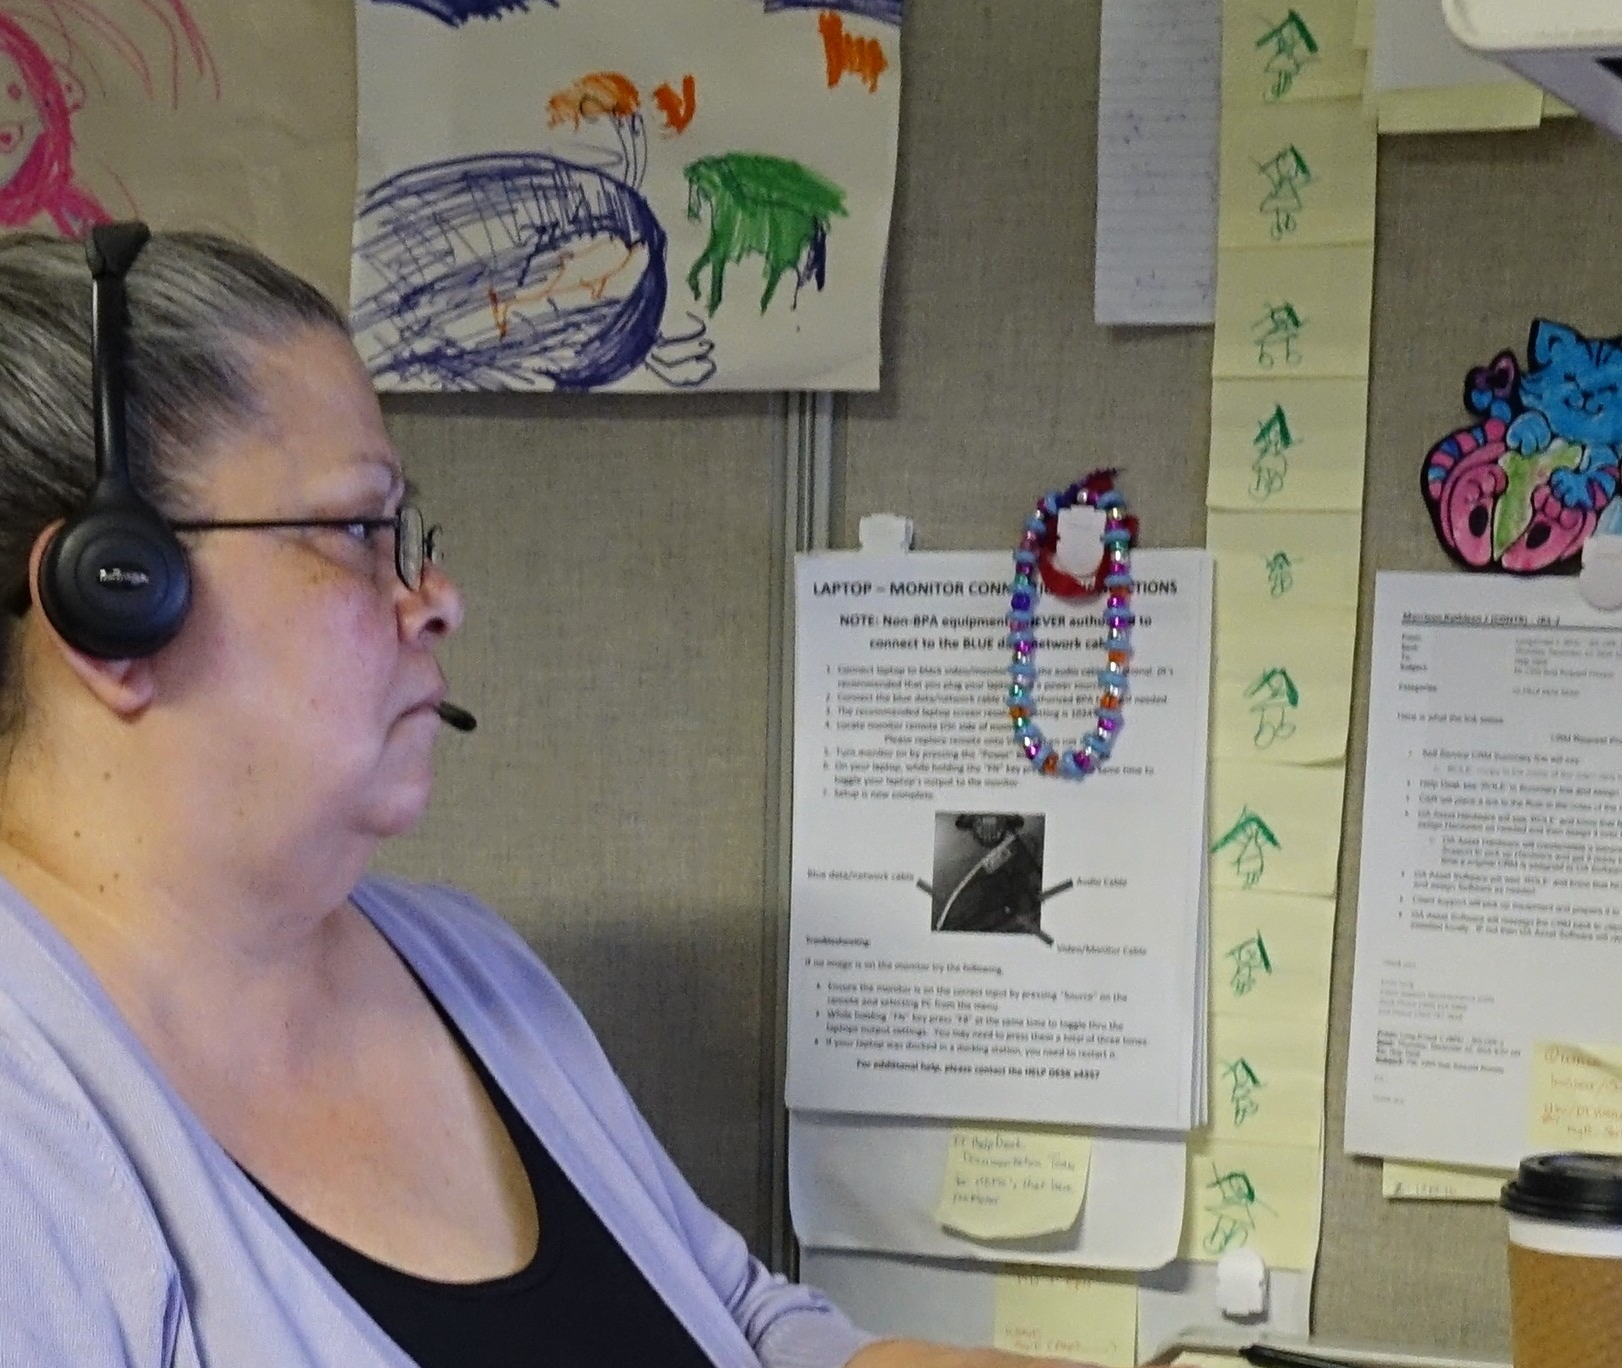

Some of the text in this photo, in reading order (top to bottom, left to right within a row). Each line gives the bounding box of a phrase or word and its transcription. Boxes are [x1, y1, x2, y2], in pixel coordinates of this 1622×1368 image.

[813, 581, 872, 596] LAPTOP
[889, 581, 964, 597] MONITOR
[883, 613, 939, 628] Non-BPA
[941, 615, 1008, 632] equipment
[869, 637, 919, 650] connect
[939, 637, 959, 650] the
[962, 637, 994, 650] BLUE
